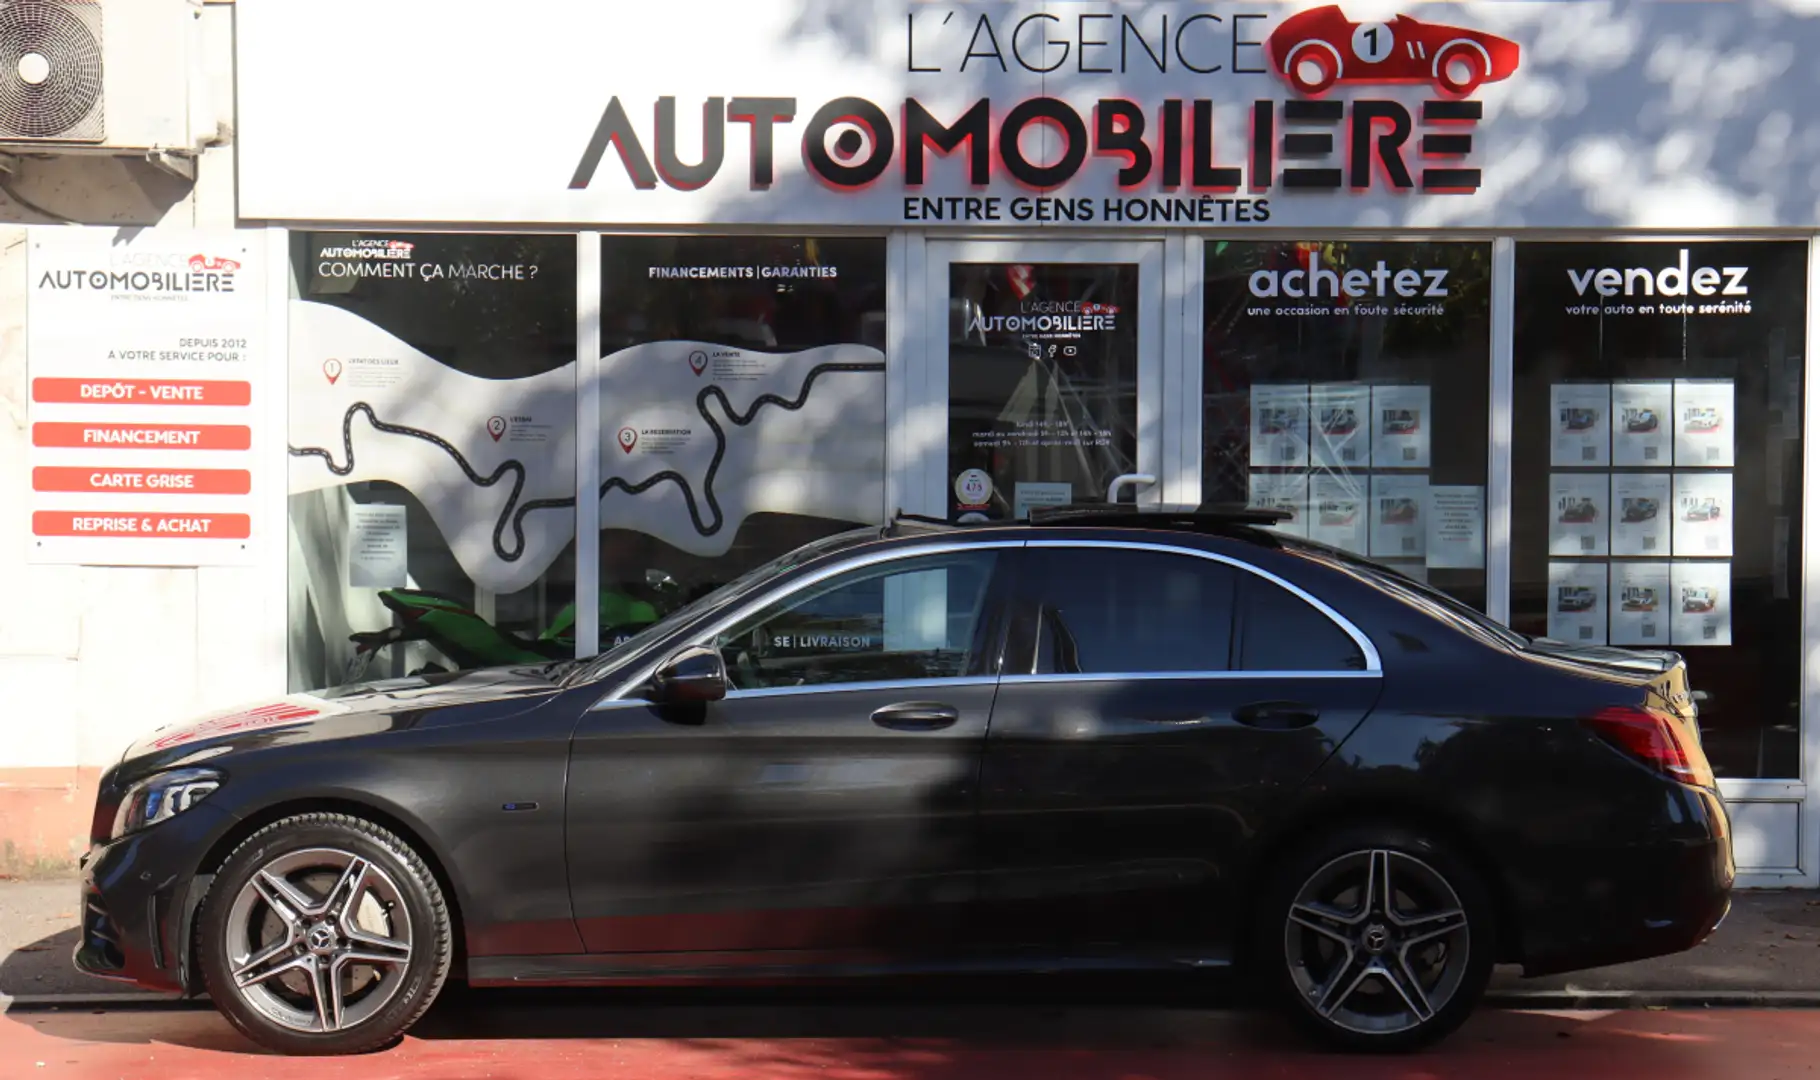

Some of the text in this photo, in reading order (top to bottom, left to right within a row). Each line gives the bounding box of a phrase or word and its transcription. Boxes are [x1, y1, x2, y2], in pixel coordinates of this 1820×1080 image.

[907, 12, 1267, 73] L'AGENCE
[1363, 28, 1377, 56] 1
[567, 96, 1483, 193] AUTOMOBILIERE
[904, 194, 1270, 222] ENTRE GENS HONNÊTES
[320, 248, 411, 259] AUTOMOBILIERE
[318, 262, 538, 281] COMMENT ÇA MARCHE ?
[649, 266, 837, 278] FINANCEMENTS GARANTIES
[1248, 251, 1449, 298] achetez
[1566, 249, 1749, 297] vendez
[39, 271, 234, 292] AUTOMOBILIERE
[1020, 301, 1080, 314] L'AGENCE
[1247, 303, 1444, 316] une occasion en toute sécurité
[1565, 304, 1599, 315] votre
[1604, 304, 1634, 315] auto
[1638, 306, 1655, 314] en
[1659, 303, 1694, 314] toute
[968, 315, 1116, 332] AUTOMOBILIERE
[179, 338, 247, 349] DEPUIS 2012
[118, 351, 156, 361] VOTRE
[160, 351, 206, 361] SERVICE
[208, 351, 240, 362] POUR
[695, 355, 702, 365] 4
[80, 382, 136, 399] DEPÔT
[150, 386, 204, 400] VENTE
[493, 420, 501, 430] 2
[83, 429, 200, 444] FINANCEMENT
[625, 432, 631, 442] 3
[90, 473, 194, 489] CARTE GRISE
[72, 517, 211, 533] REPRISE & ACHAT
[800, 635, 870, 647] LIVRAISON
